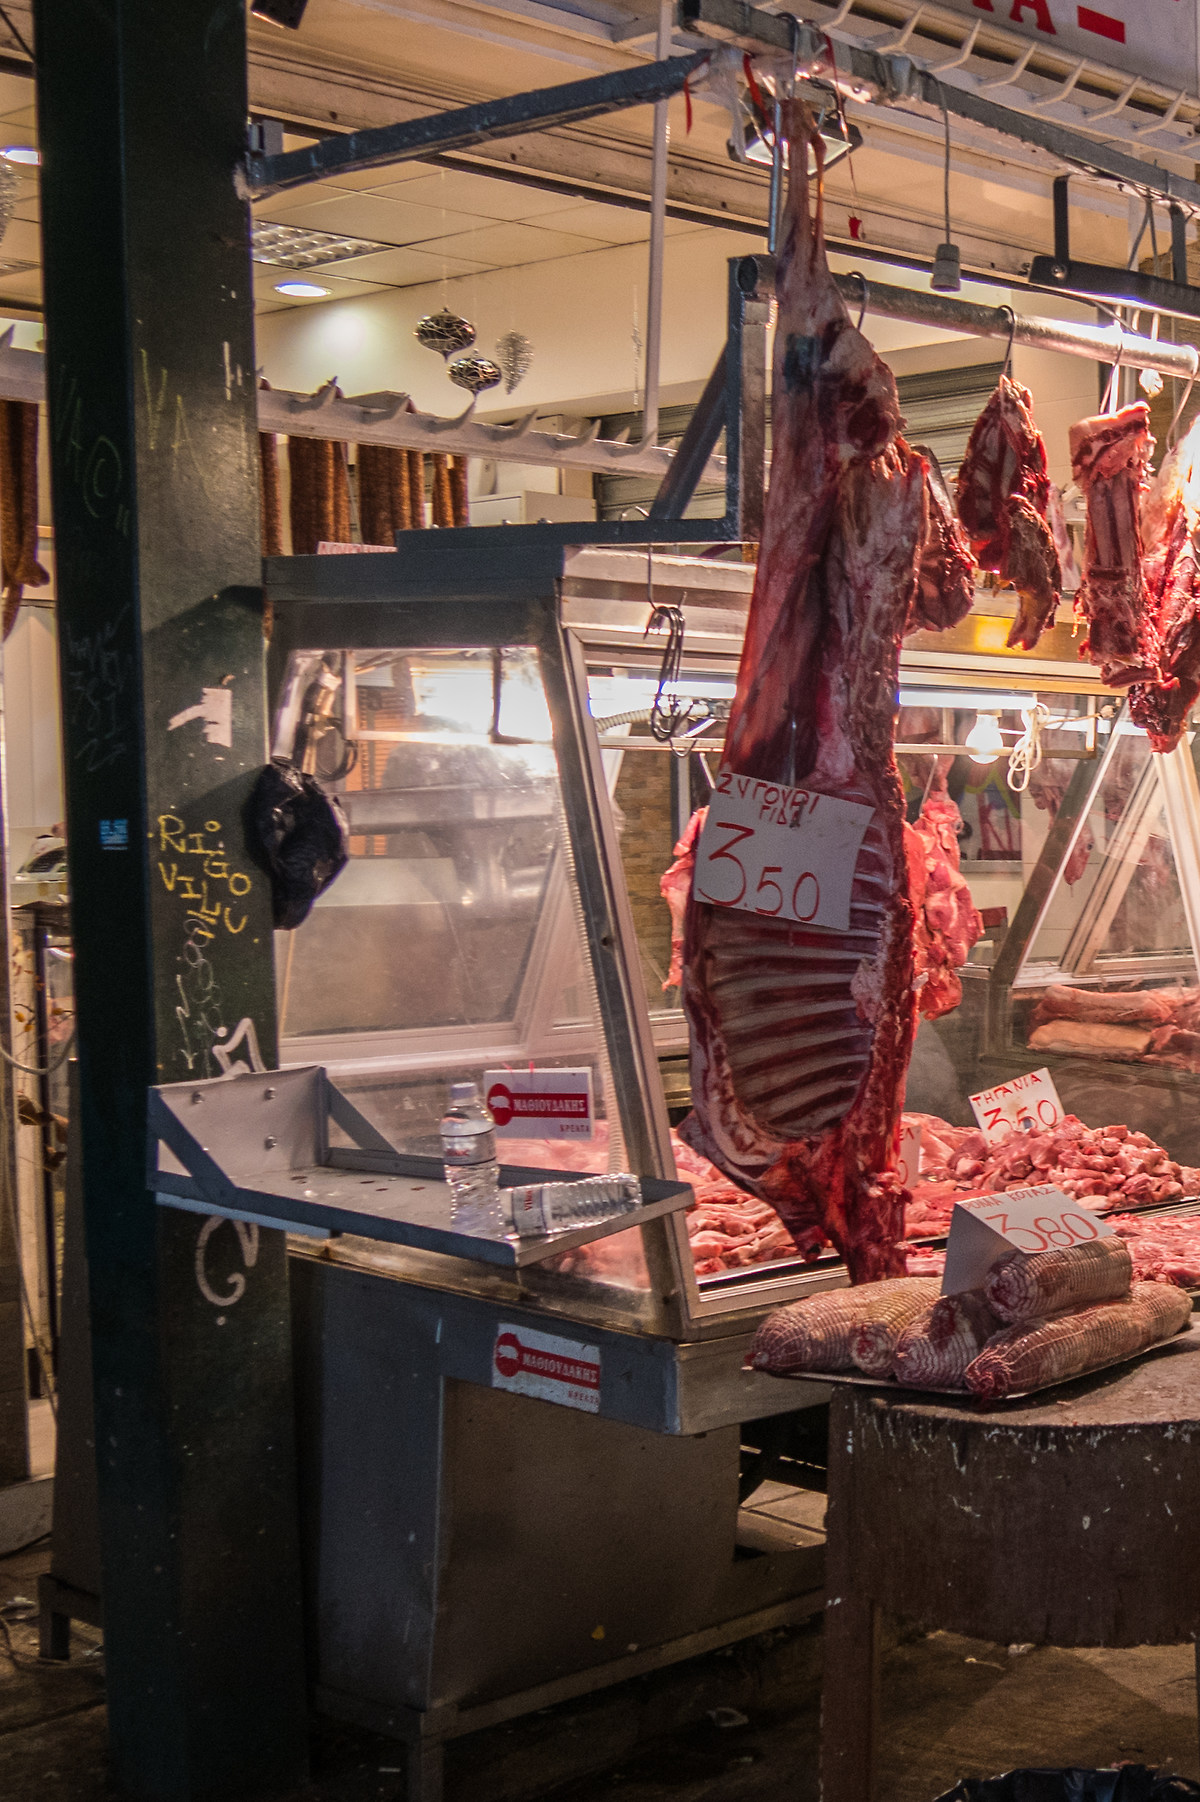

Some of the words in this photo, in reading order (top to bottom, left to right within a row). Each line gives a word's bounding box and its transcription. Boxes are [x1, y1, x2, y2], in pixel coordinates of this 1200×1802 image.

[716, 773, 820, 815] ΖΥΓΟΥΡΙ
[697, 821, 821, 922] 3.50
[513, 1099, 586, 1113] ΜΑΘΙΟΥΔΑΚΗΣ
[971, 1072, 1043, 1108] ΤΗΓΑΝΙΑ
[983, 1099, 1059, 1134] 3.50
[1005, 1186, 1056, 1202] ΚΟΤΑΣ
[985, 1211, 1099, 1252] 3.80
[522, 1352, 598, 1384] ΜΑΘΙΟΥΔΑΚΗΣ
